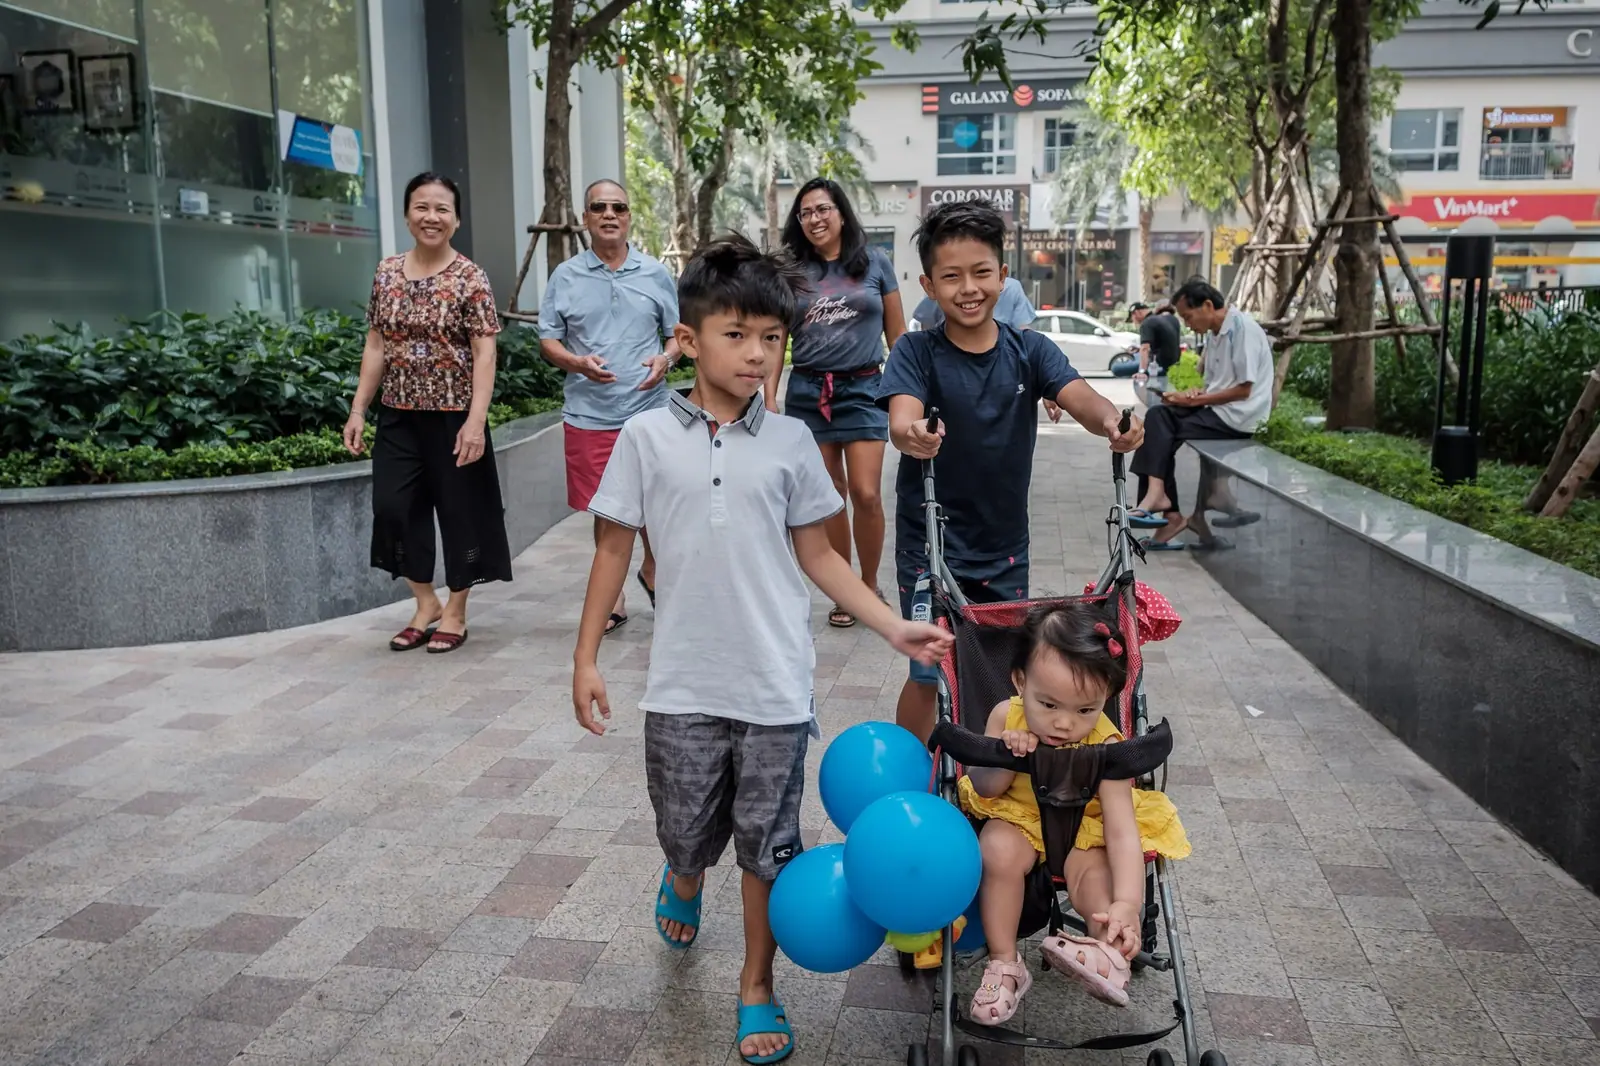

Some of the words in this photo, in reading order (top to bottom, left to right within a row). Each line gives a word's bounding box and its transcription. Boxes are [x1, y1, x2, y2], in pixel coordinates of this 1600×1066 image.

[1566, 29, 1594, 57] C
[950, 90, 1009, 105] GALAXY
[1037, 88, 1073, 102] SOFA
